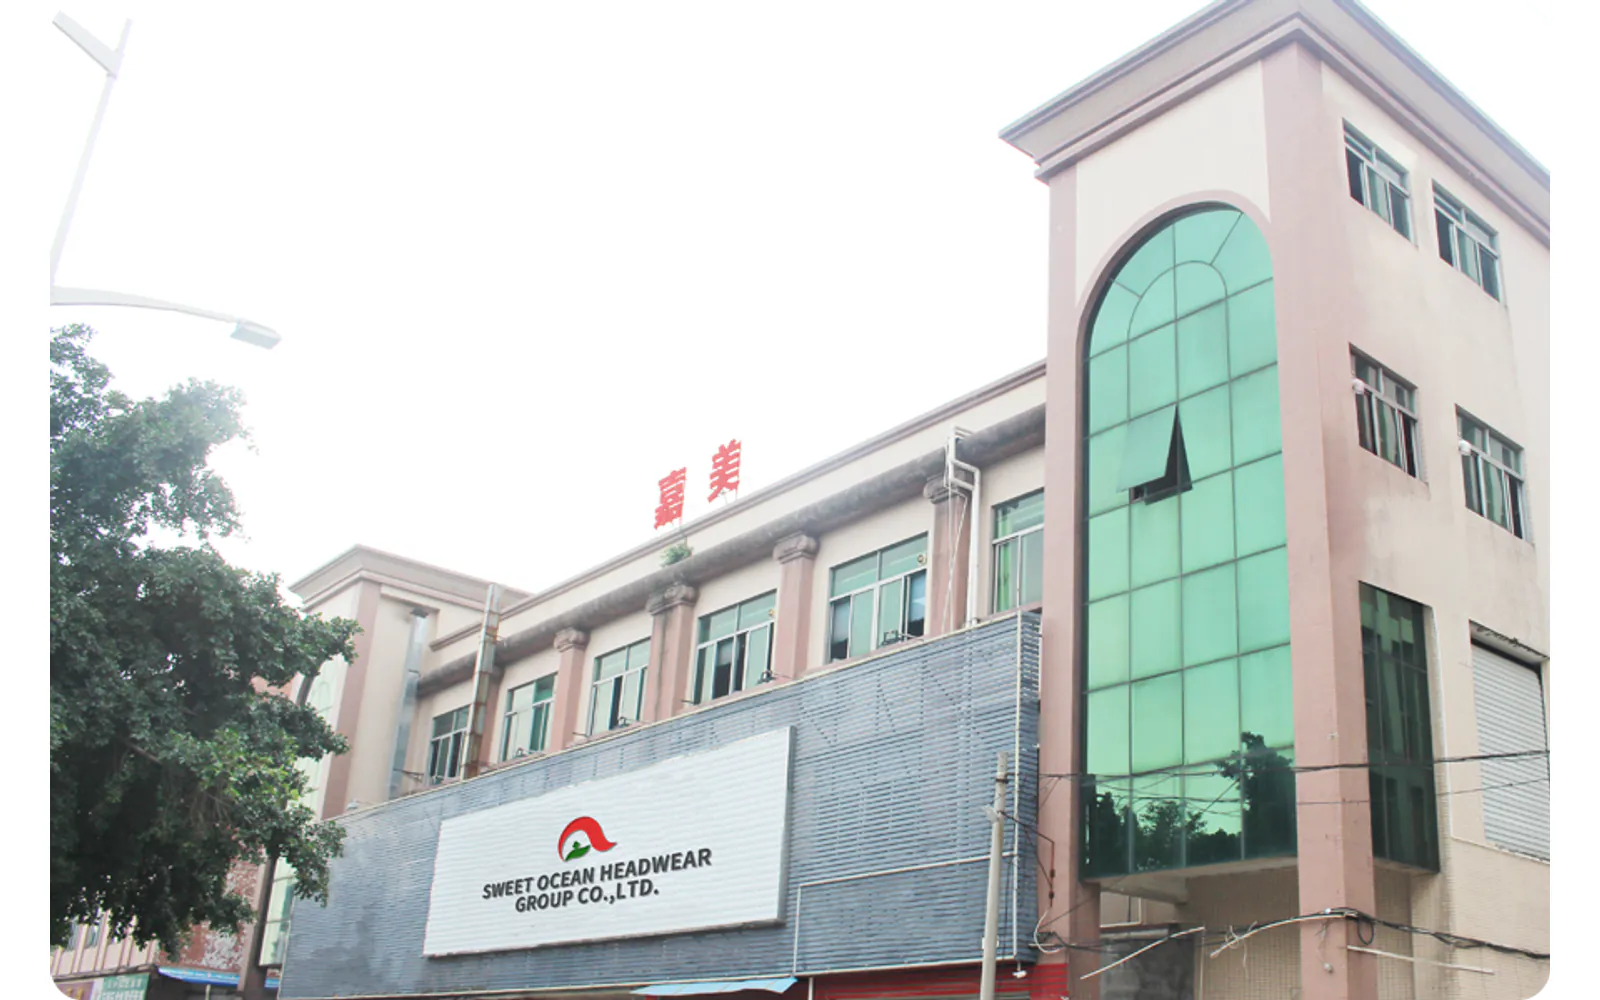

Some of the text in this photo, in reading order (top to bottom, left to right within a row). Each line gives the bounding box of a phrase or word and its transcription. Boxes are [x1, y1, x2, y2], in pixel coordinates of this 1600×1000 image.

[653, 439, 742, 531] 嘉美
[482, 848, 712, 900] SWEET OCEAN HEADWEAR
[515, 878, 660, 913] GROUP CO.,LTD.
